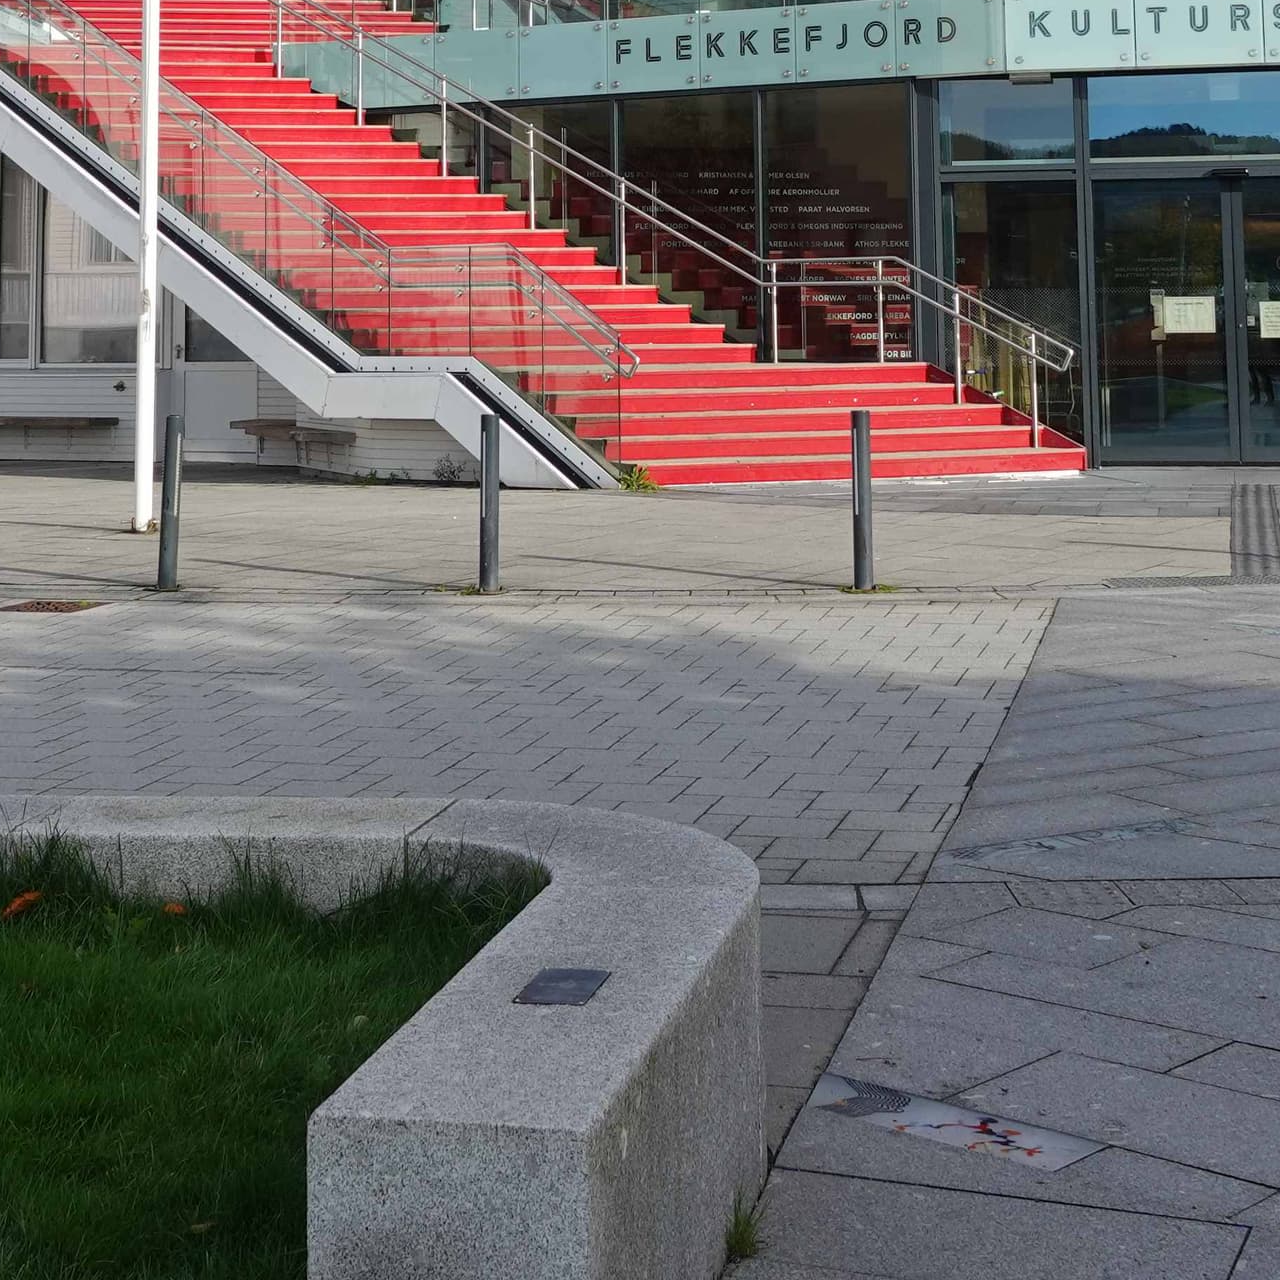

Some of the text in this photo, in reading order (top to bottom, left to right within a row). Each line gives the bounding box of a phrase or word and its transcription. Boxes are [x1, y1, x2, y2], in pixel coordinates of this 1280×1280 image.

[615, 16, 957, 64] FLEKKEFJORD
[786, 172, 810, 180] OLSEN
[881, 240, 910, 248] FLEKKE
[812, 294, 847, 302] NORWAY
